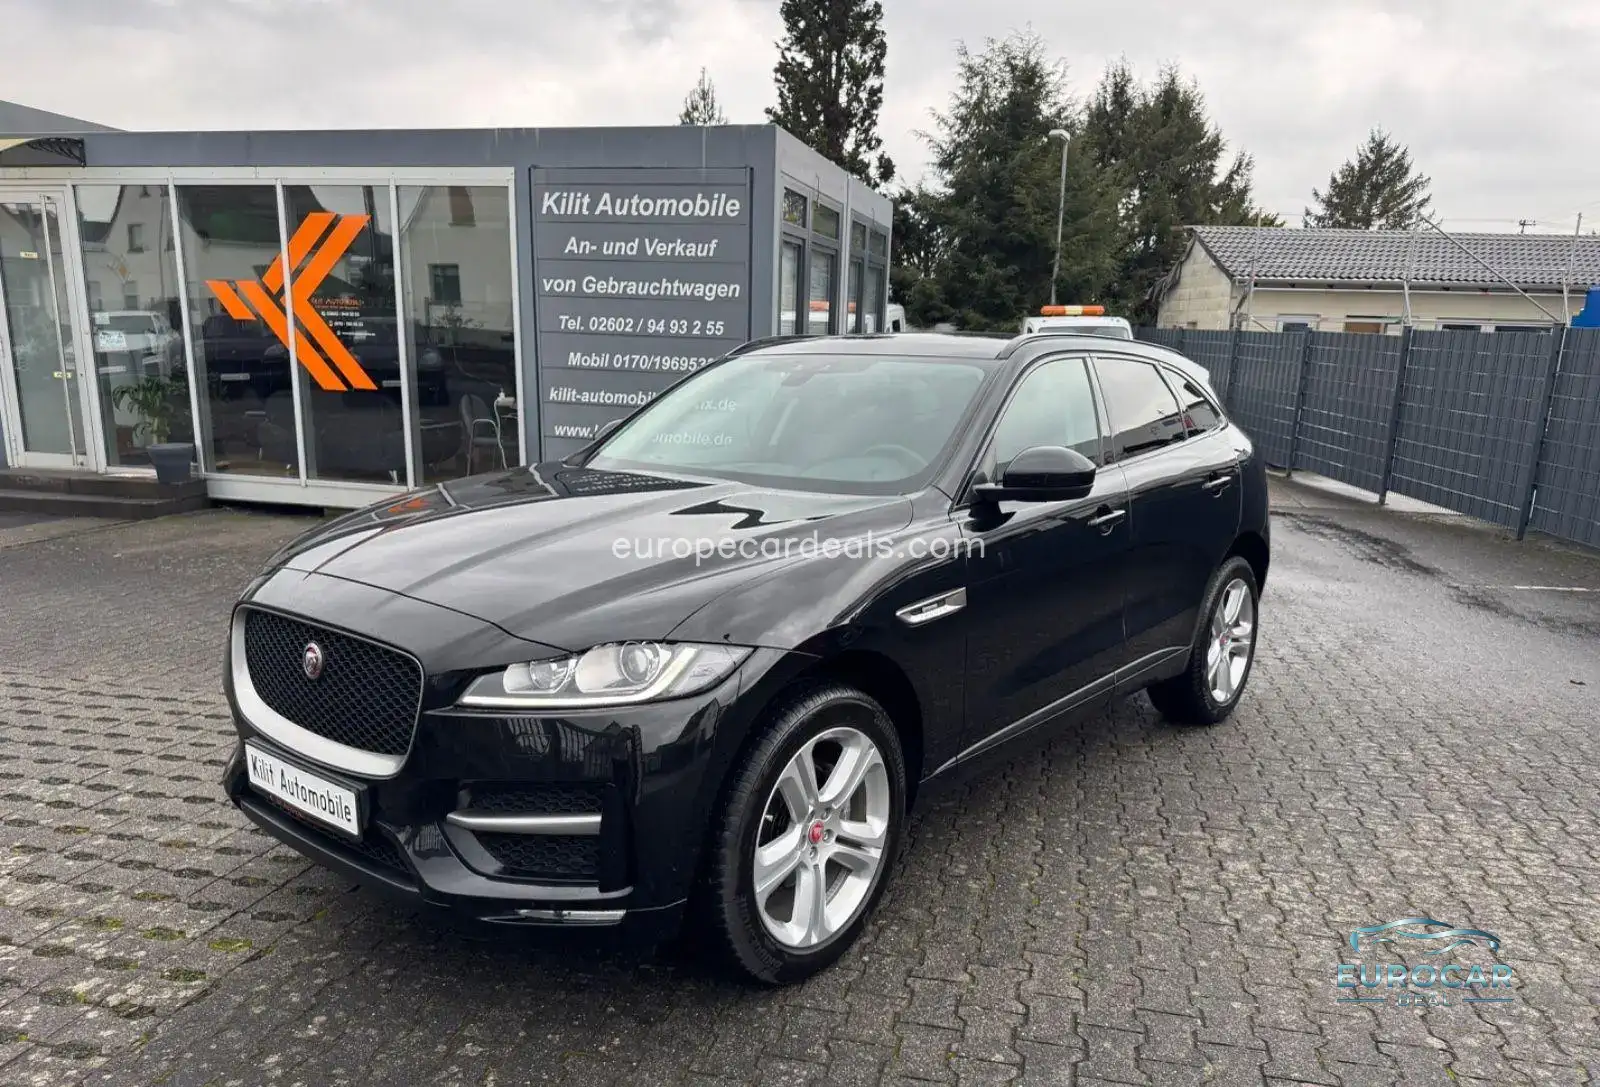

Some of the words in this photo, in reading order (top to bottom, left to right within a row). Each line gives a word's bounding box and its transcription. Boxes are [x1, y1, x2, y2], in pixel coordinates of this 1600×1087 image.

[541, 192, 591, 215] Kilit
[594, 192, 740, 217] Automobile
[564, 236, 597, 254] An-
[602, 237, 639, 256] und
[644, 238, 718, 257] Verkauf
[542, 278, 576, 293] von
[582, 275, 740, 301] Gebrauchtwagen
[558, 315, 584, 331] Tel.
[589, 316, 633, 332] 02602
[636, 318, 644, 332] /
[647, 319, 665, 334] 94
[669, 319, 688, 335] 93
[692, 320, 702, 335] 2
[705, 320, 724, 336] 55
[568, 352, 608, 368] Mobil
[251, 753, 275, 786] Kilit
[280, 768, 352, 822] Automobile
